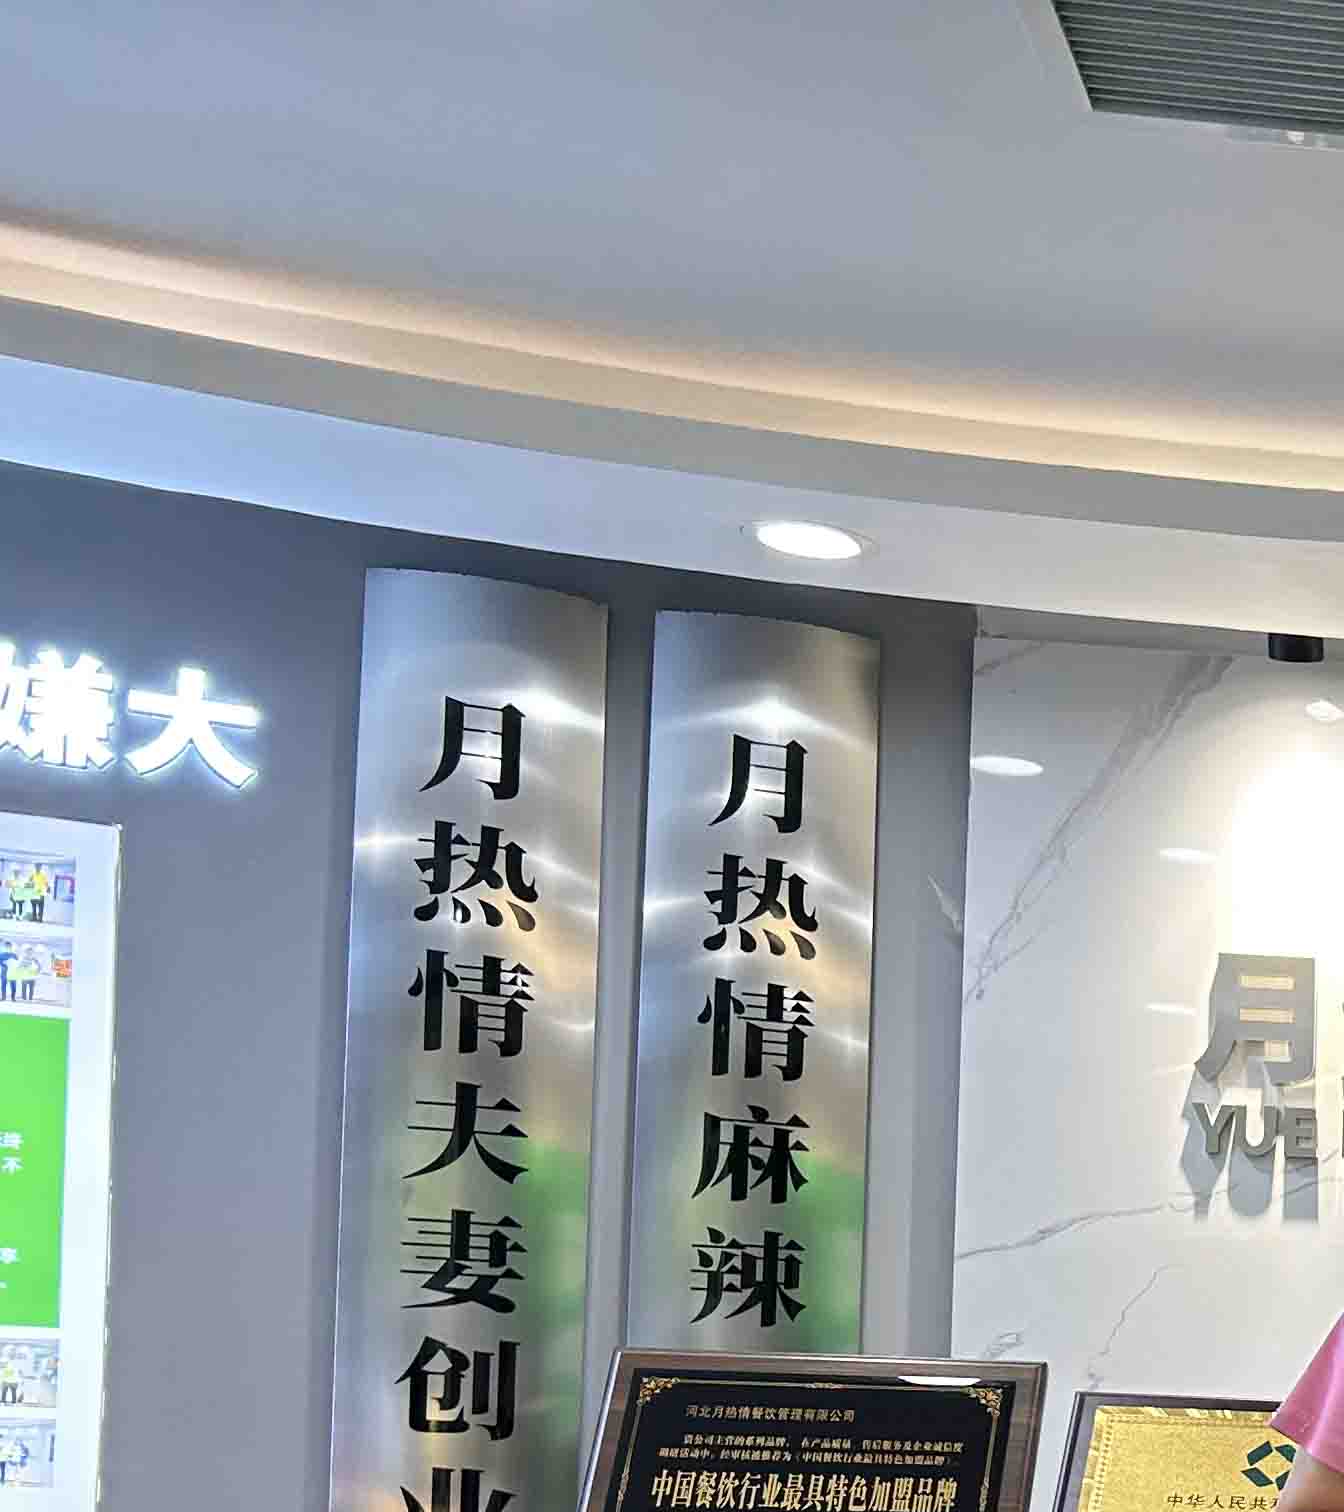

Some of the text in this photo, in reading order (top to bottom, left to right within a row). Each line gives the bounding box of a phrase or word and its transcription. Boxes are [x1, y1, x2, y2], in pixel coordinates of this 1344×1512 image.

[690, 733, 820, 1328] 月热情麻辣
[1192, 1102, 1318, 1160] YUE
